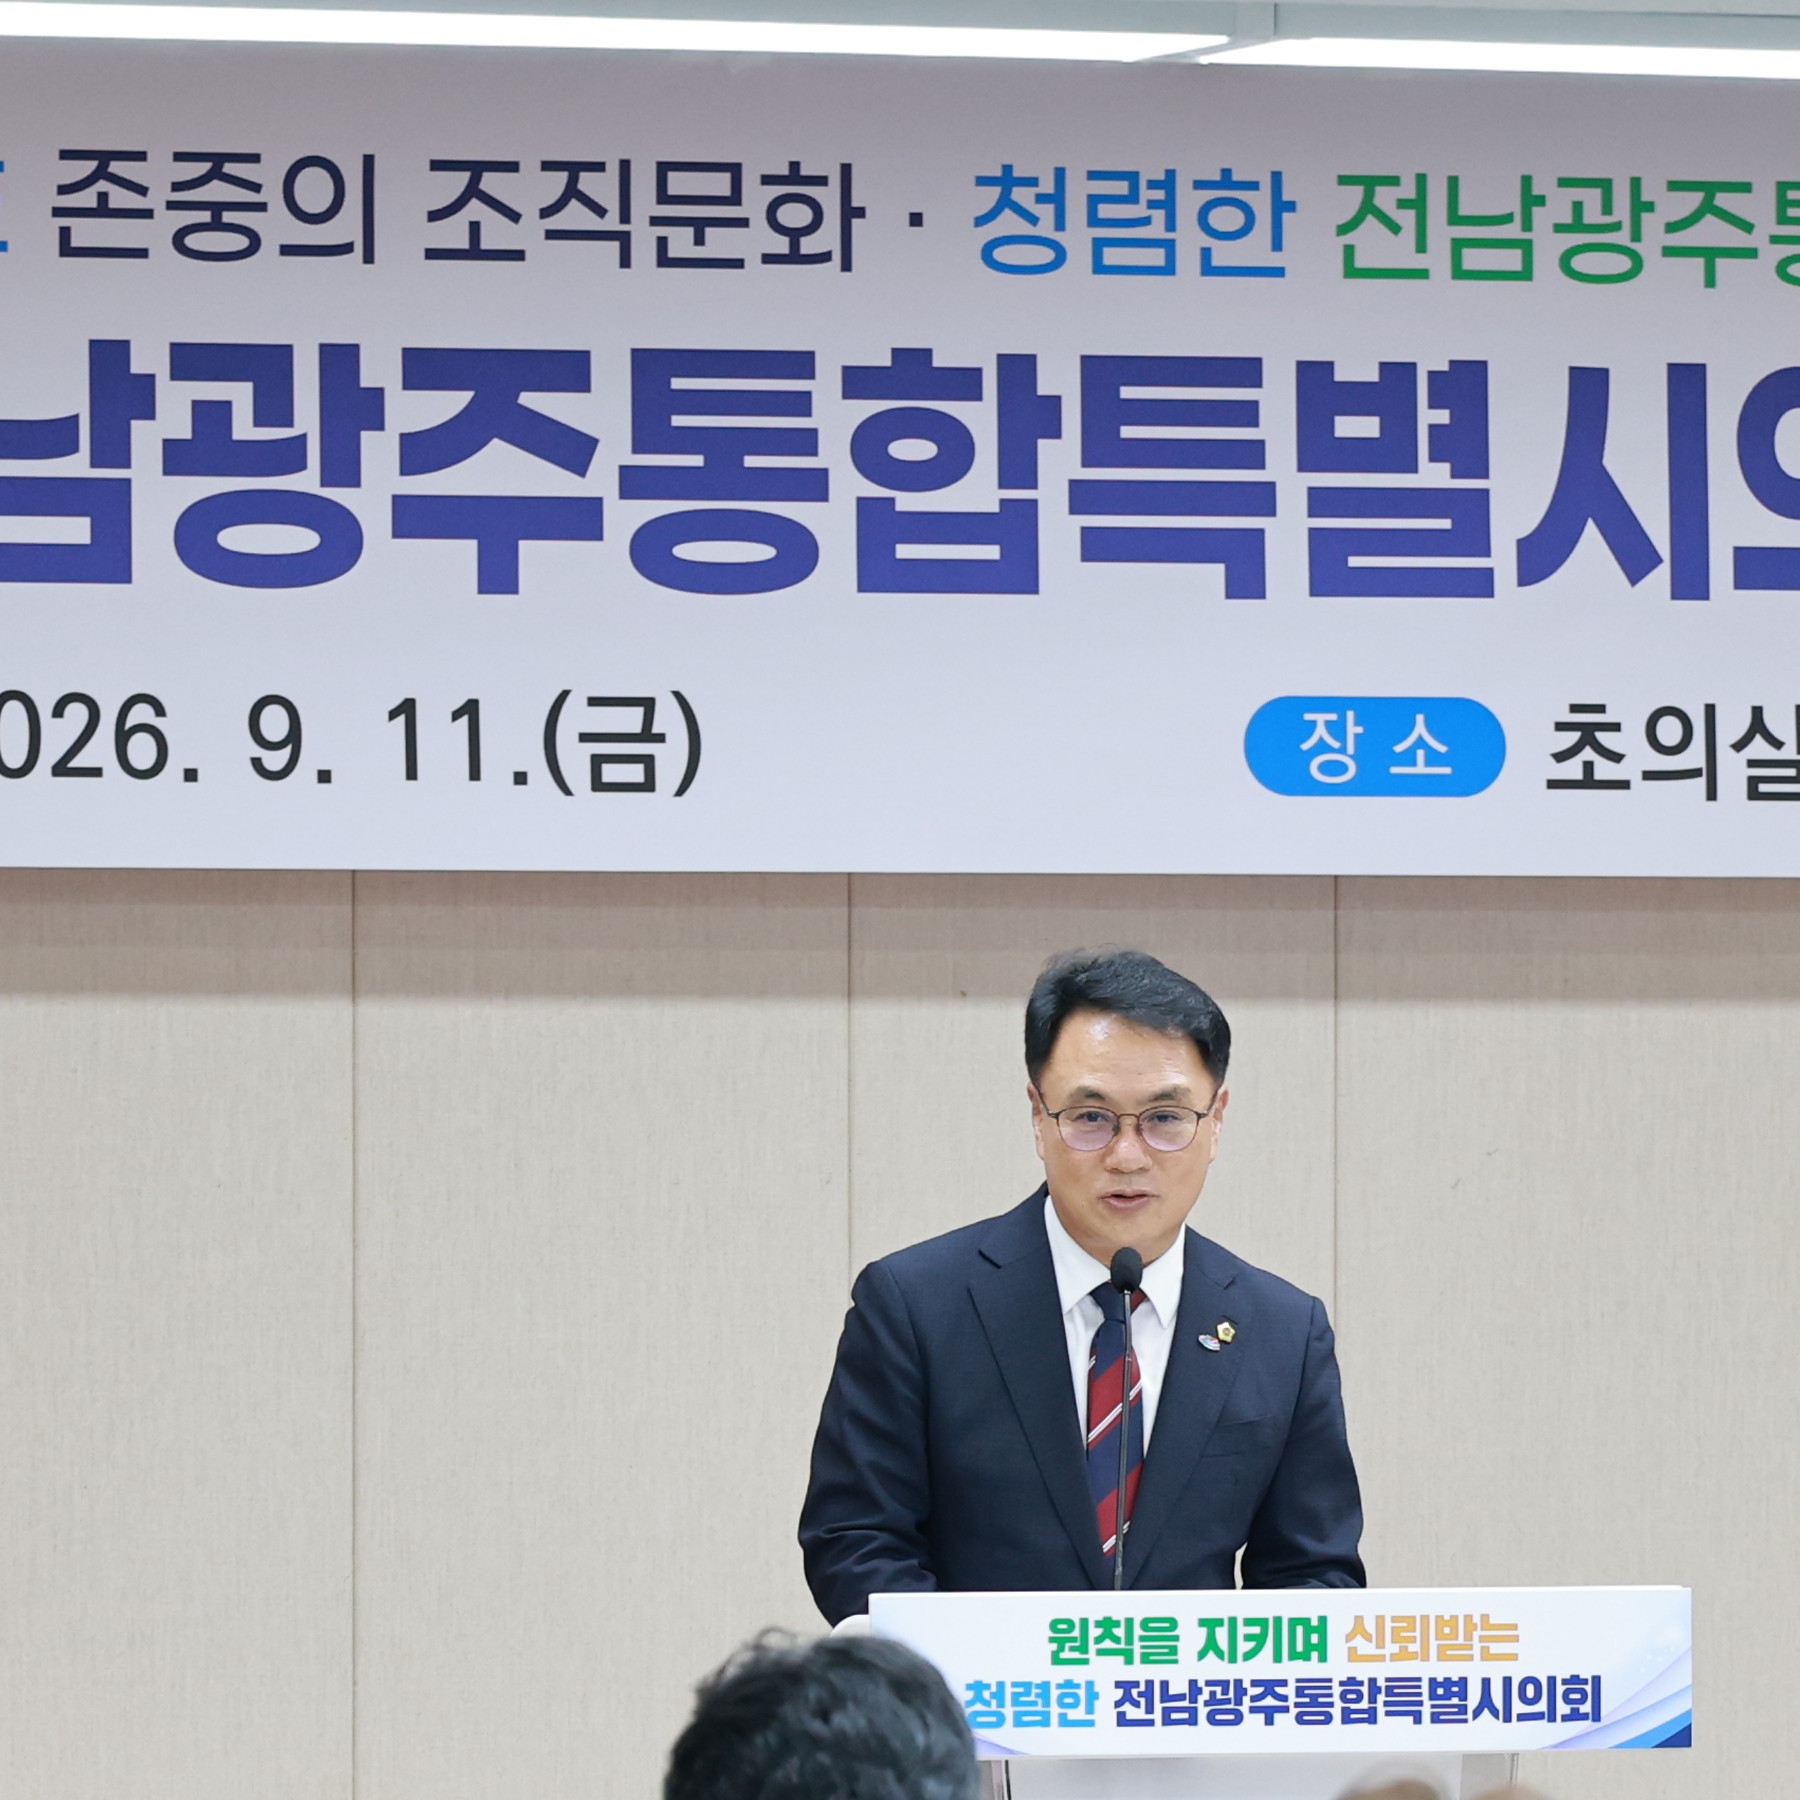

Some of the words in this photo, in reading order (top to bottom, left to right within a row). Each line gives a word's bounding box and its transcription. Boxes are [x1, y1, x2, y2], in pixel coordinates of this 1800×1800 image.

[52, 149, 375, 264] 존중의
[425, 159, 866, 272] 조직문화
[974, 164, 1296, 277] 청렴한
[248, 694, 332, 784] 9.
[388, 689, 701, 797] 11.(금)
[1049, 1617, 1179, 1665] 원칙을
[1198, 1616, 1327, 1664] 지키며
[1346, 1615, 1519, 1662] 신뢰받는
[964, 1678, 1100, 1728] 청렴한
[1114, 1675, 1601, 1727] 전남광주통합특별시의회
